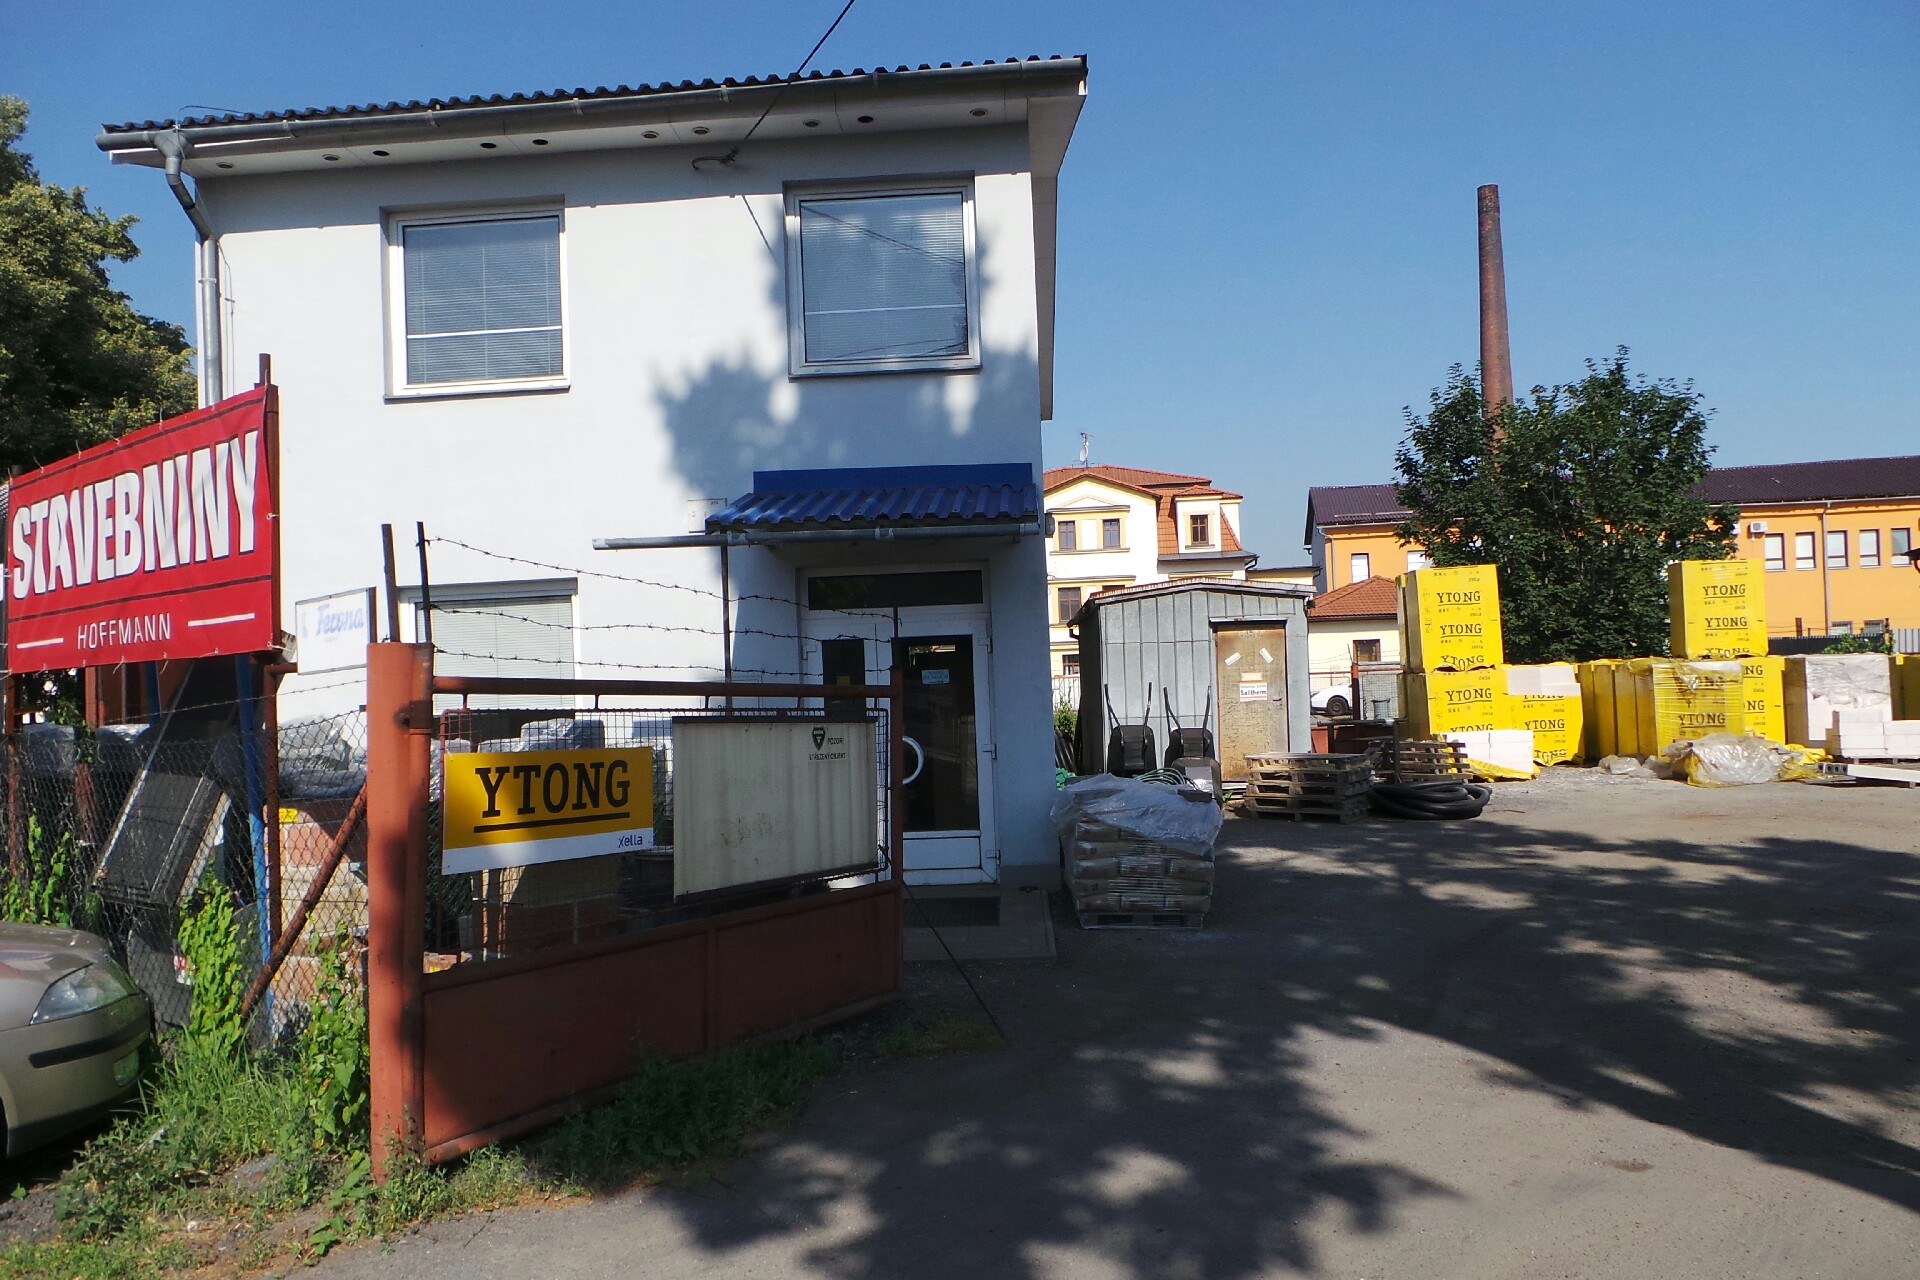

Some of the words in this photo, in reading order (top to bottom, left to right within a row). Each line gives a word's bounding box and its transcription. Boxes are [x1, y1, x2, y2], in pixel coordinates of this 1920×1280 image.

[13, 430, 259, 599] STAVEBNINY
[1702, 584, 1746, 596] YTONG
[1436, 591, 1481, 603] YTONG
[1705, 617, 1748, 628] YTONG
[77, 612, 171, 650] HOFFMANN
[1440, 624, 1483, 635] YTONG
[1441, 655, 1485, 671] YTONG
[1445, 688, 1492, 701] YTONG
[1524, 719, 1565, 730] YTONG
[1678, 713, 1726, 725] YTONG
[1533, 749, 1567, 764] TONG
[474, 760, 631, 819] YTONG
